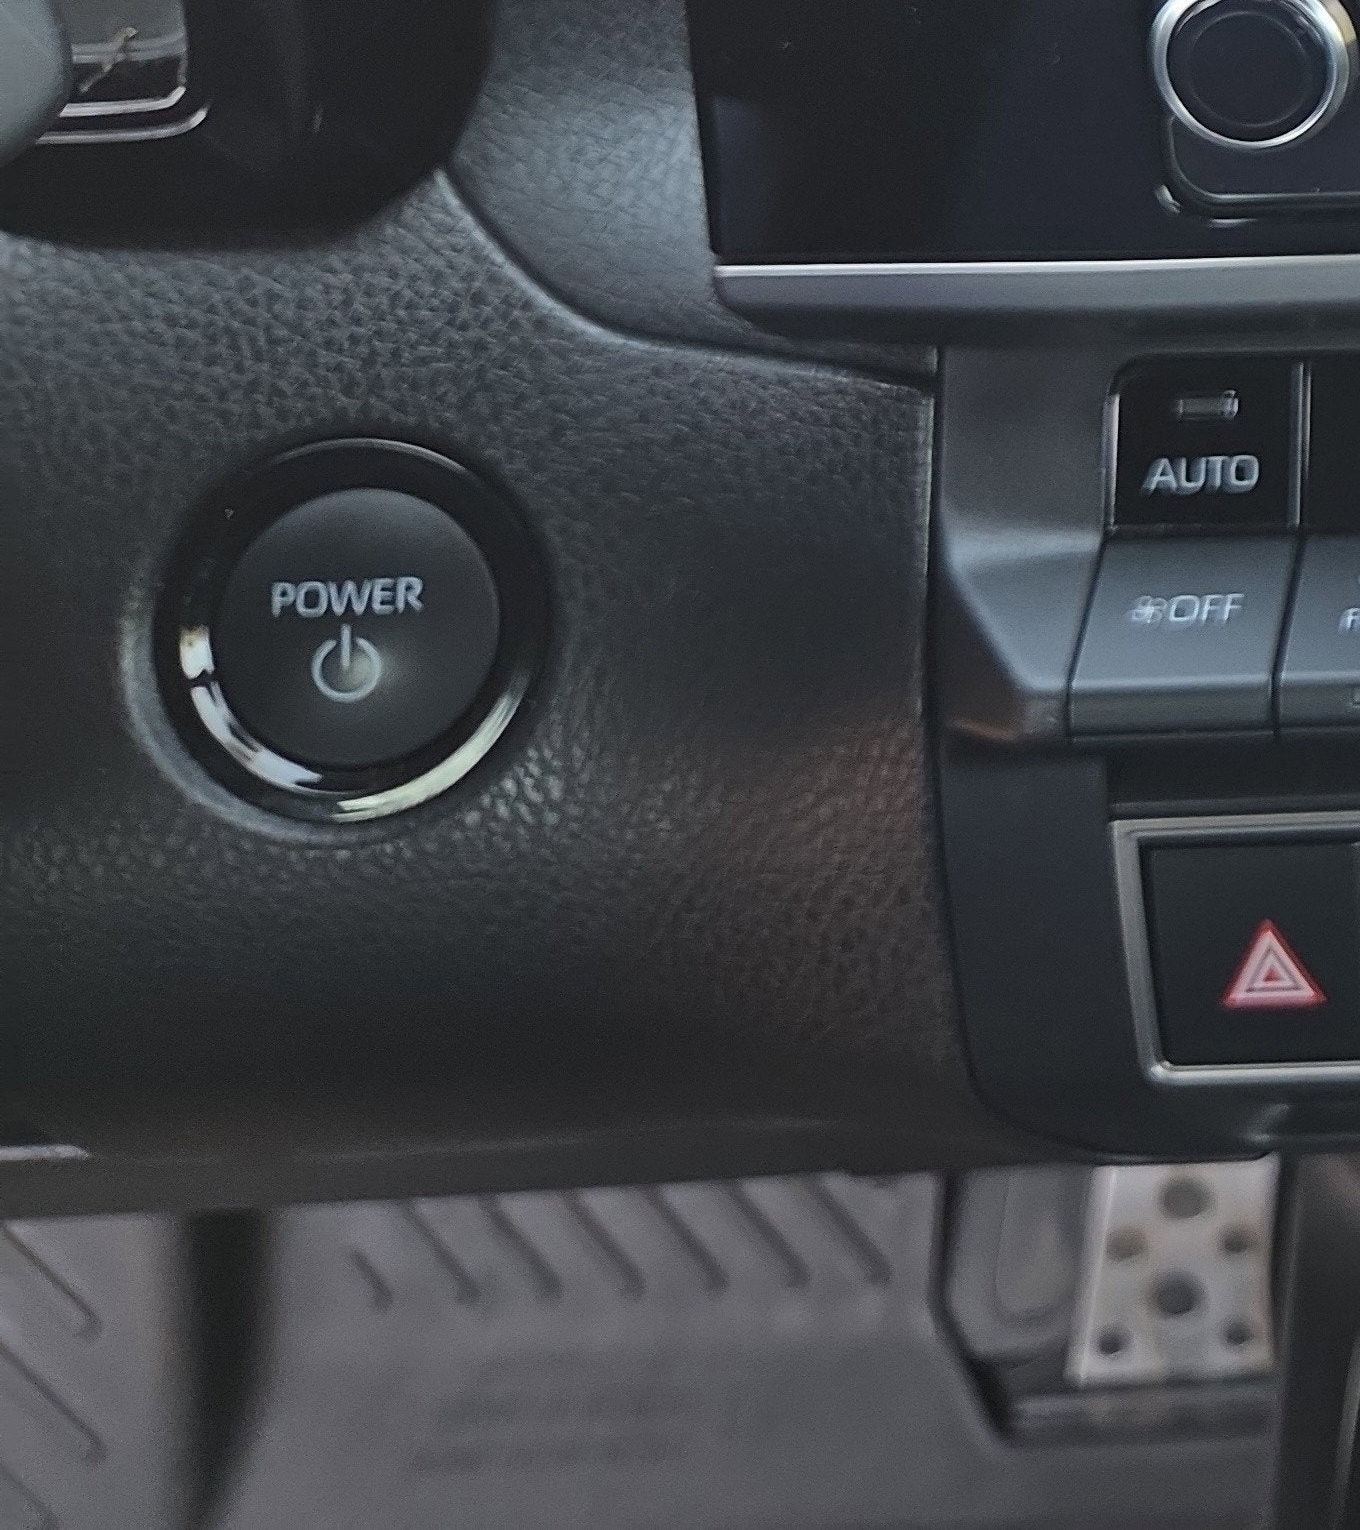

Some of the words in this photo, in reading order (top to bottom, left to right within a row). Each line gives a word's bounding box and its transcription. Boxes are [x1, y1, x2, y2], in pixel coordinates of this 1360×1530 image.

[1145, 454, 1260, 492] AUTO
[271, 576, 423, 617] POWER
[1168, 590, 1248, 626] OFF
